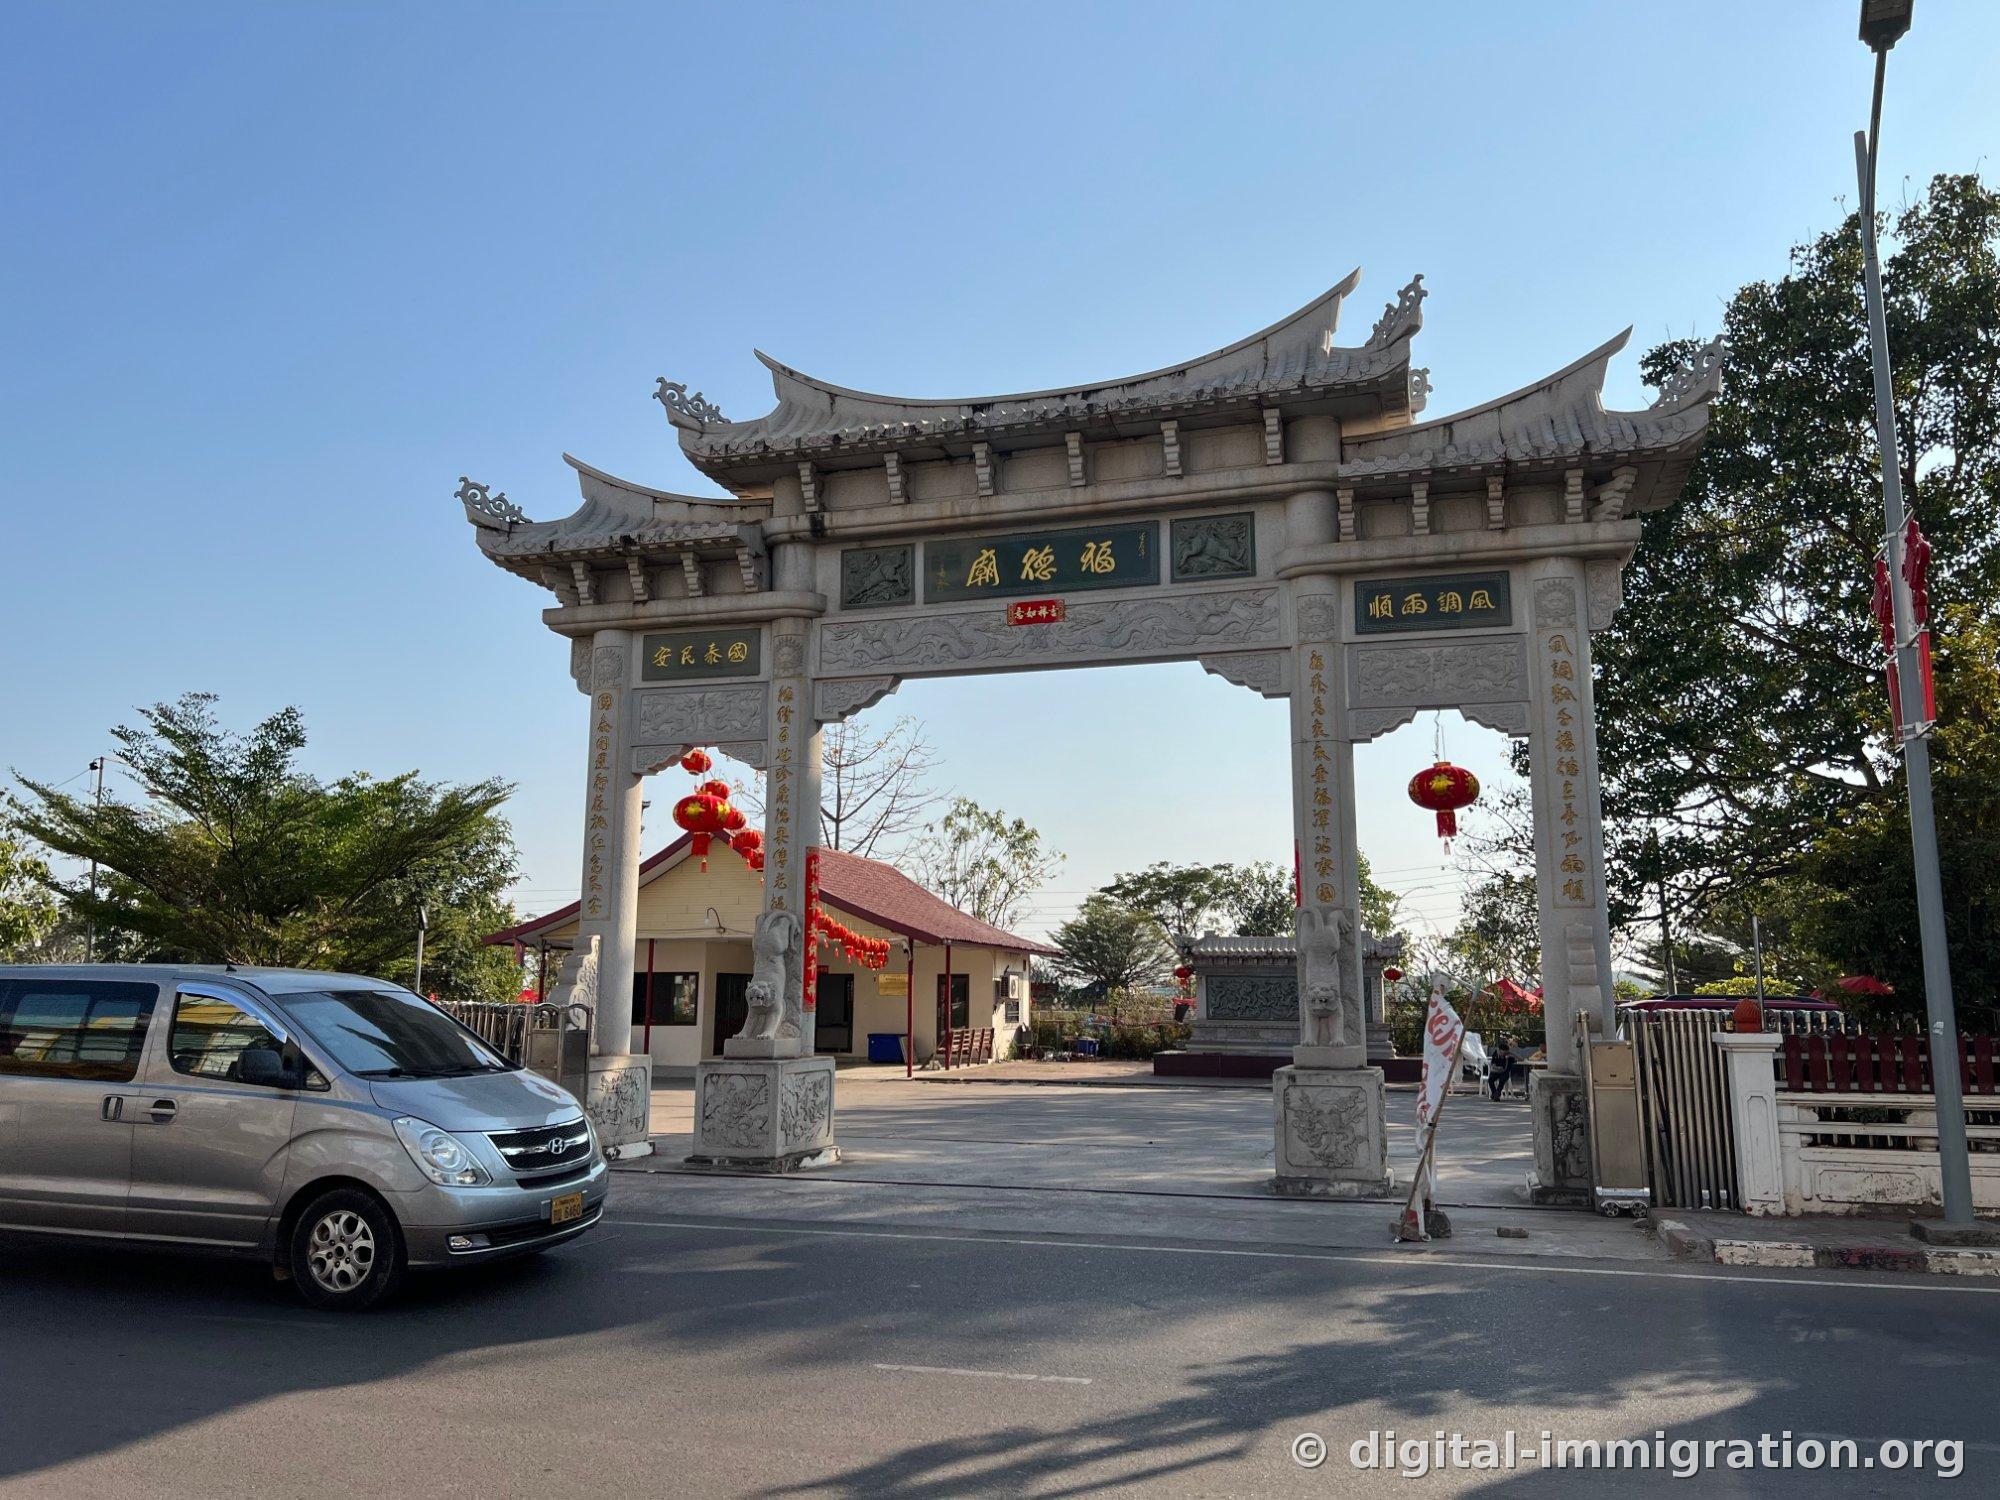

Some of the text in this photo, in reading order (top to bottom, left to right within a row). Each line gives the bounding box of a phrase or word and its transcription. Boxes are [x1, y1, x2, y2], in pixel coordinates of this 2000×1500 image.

[965, 540, 1116, 587] 福德廟
[1369, 590, 1496, 619] 風調雨順
[652, 641, 748, 667] 國泰民安
